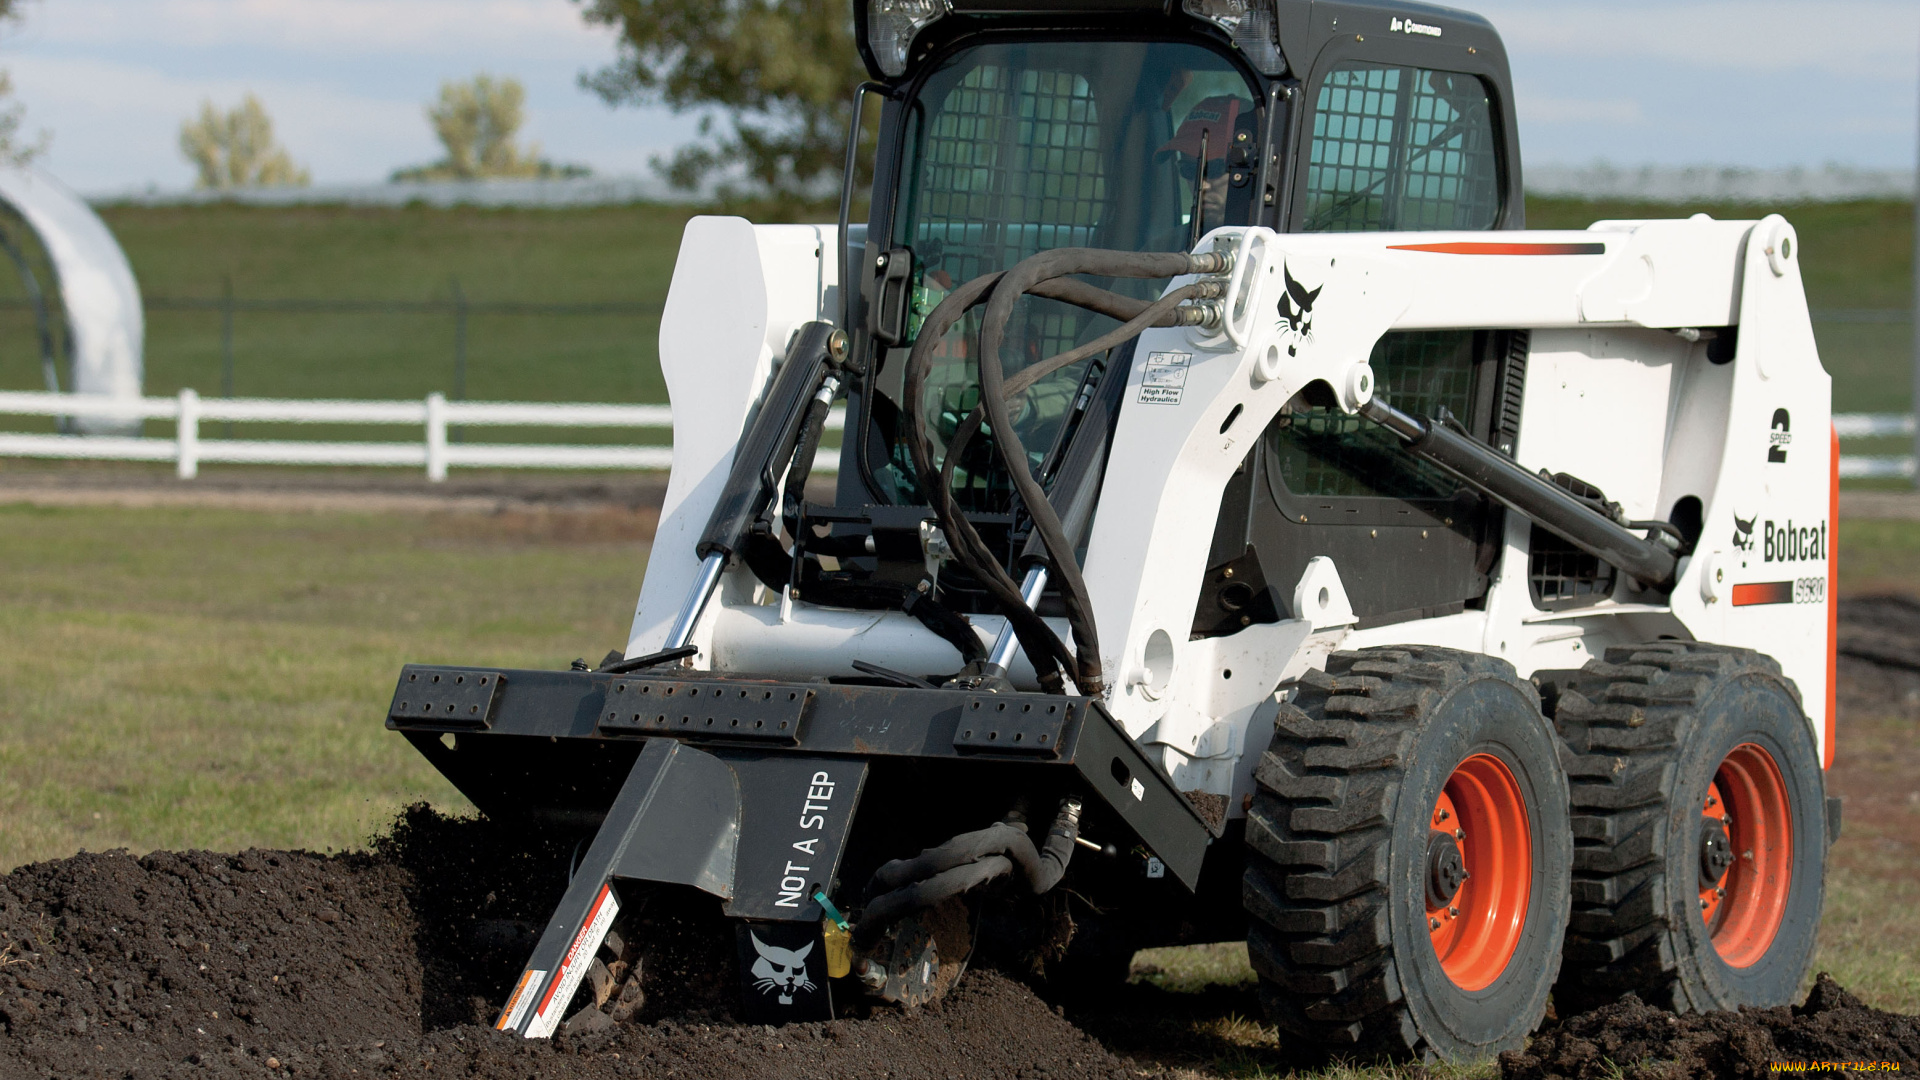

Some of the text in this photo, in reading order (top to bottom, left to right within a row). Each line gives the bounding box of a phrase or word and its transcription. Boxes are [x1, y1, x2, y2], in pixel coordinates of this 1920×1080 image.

[1140, 395, 1178, 403] Hydraulics
[1161, 388, 1179, 396] Flow
[1767, 407, 1790, 463] 2
[1769, 432, 1792, 444] SPEED
[1764, 519, 1826, 562] Bobcat
[1795, 577, 1825, 604] S630
[774, 771, 836, 908] NOT A STEP
[552, 977, 566, 1004] AVOID
[565, 950, 581, 979] INJURY
[587, 910, 602, 939] DEATH
[567, 925, 587, 961] DANGER
